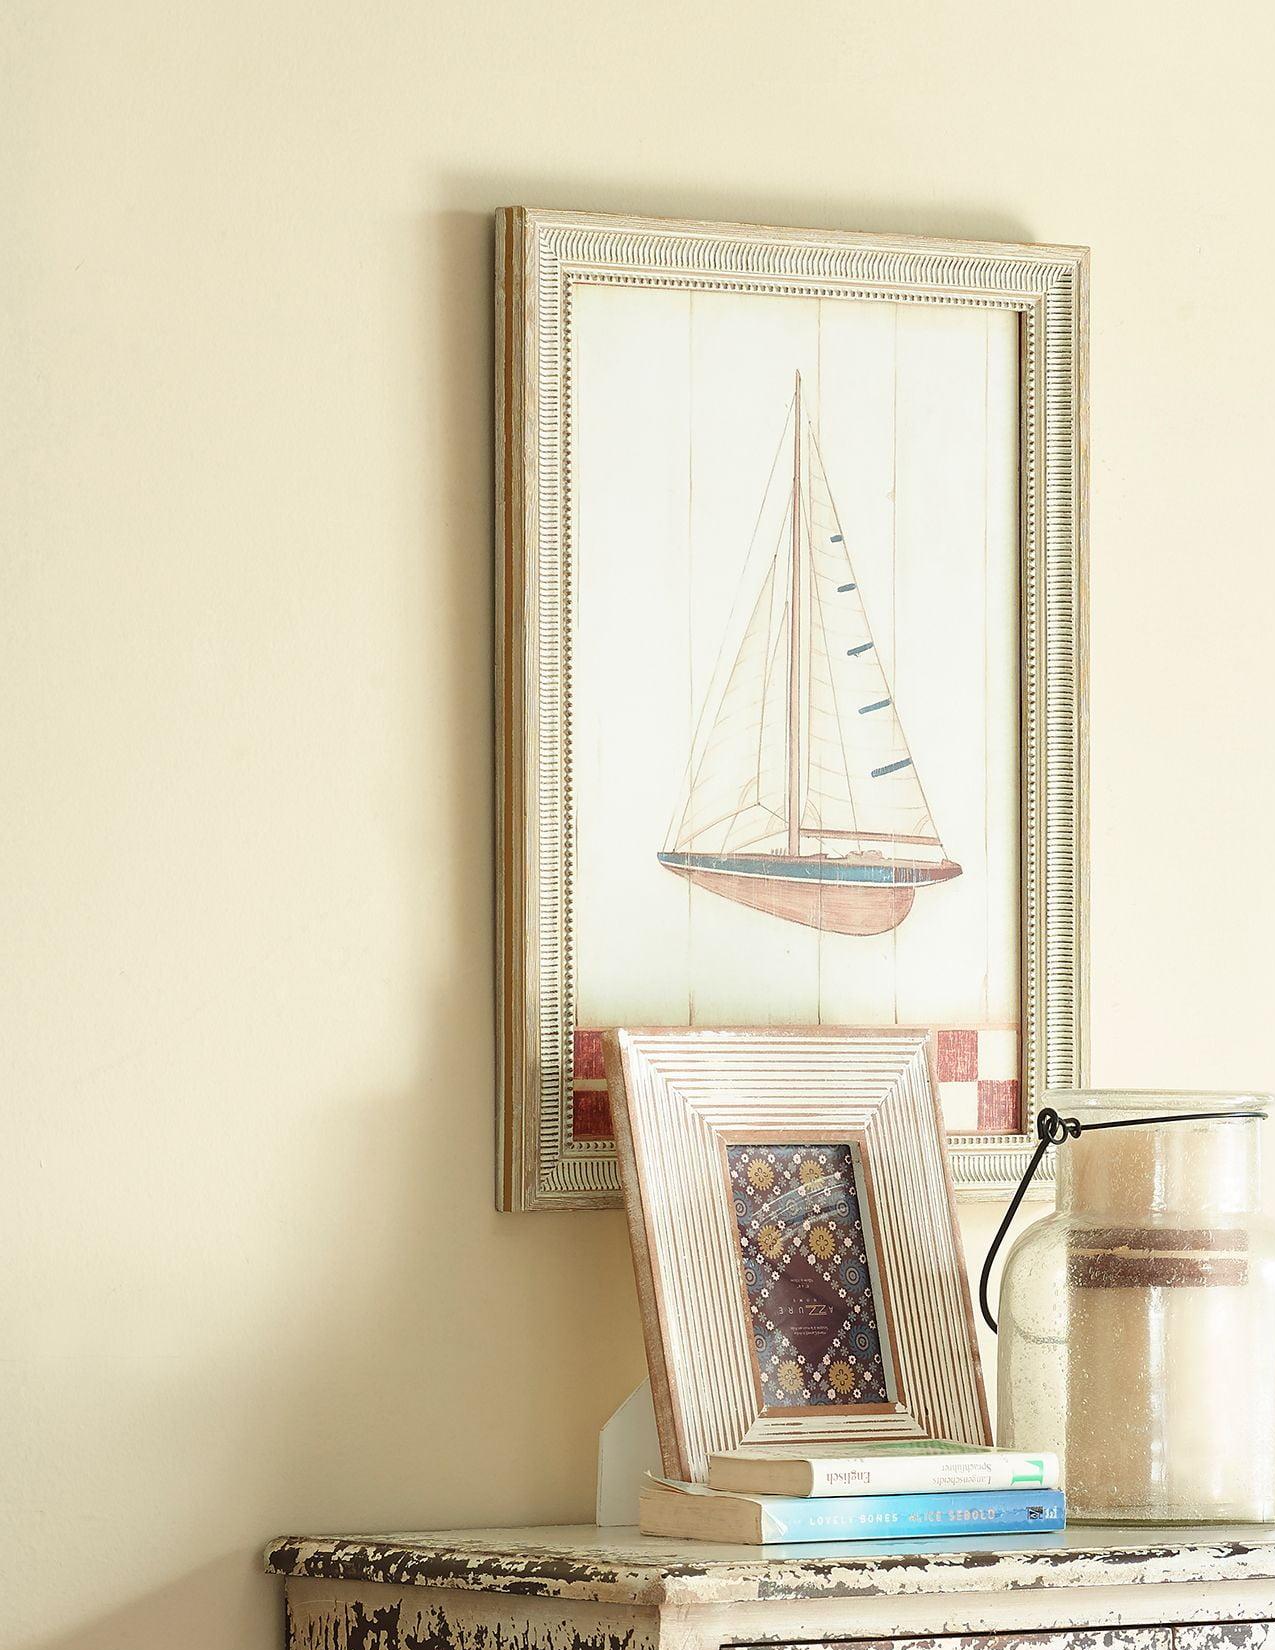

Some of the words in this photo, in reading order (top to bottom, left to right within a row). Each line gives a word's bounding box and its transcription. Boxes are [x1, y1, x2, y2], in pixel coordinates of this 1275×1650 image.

[779, 1304, 834, 1316] AZZURE
[825, 1468, 872, 1485] Englisch
[930, 1473, 992, 1487] Langenscheidts
[859, 1512, 898, 1524] BONES
[947, 1508, 996, 1522] SEBOLD
